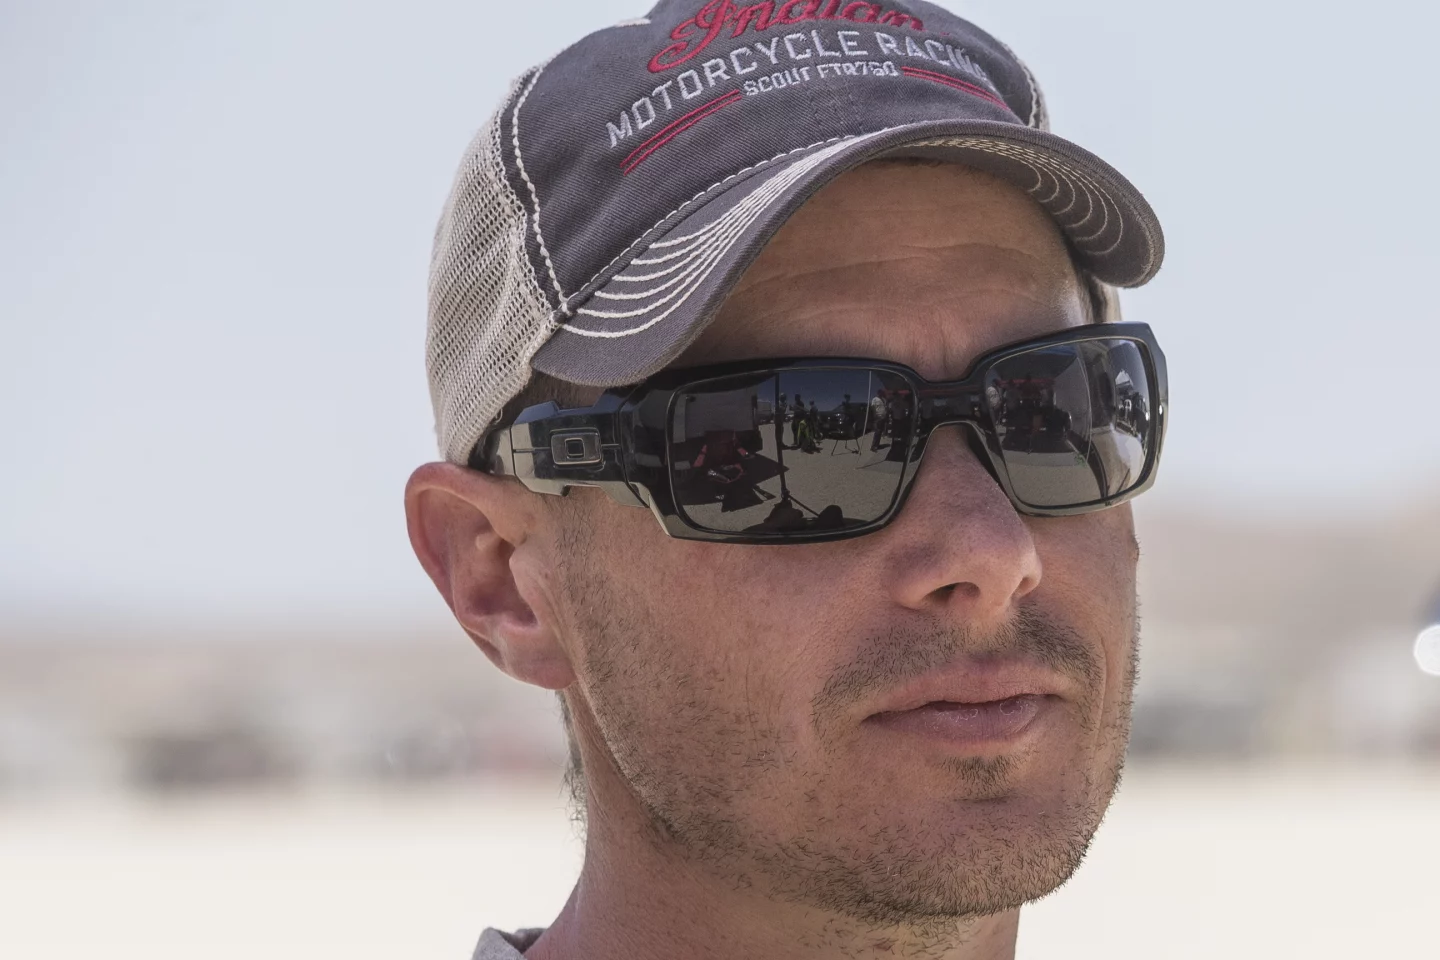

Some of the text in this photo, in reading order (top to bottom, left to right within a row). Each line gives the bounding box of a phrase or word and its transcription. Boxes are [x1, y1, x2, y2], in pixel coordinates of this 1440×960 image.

[647, 0, 927, 73] Indian
[605, 30, 869, 149] MOTORCYCLE
[743, 60, 900, 96] SCOUT FTR750
